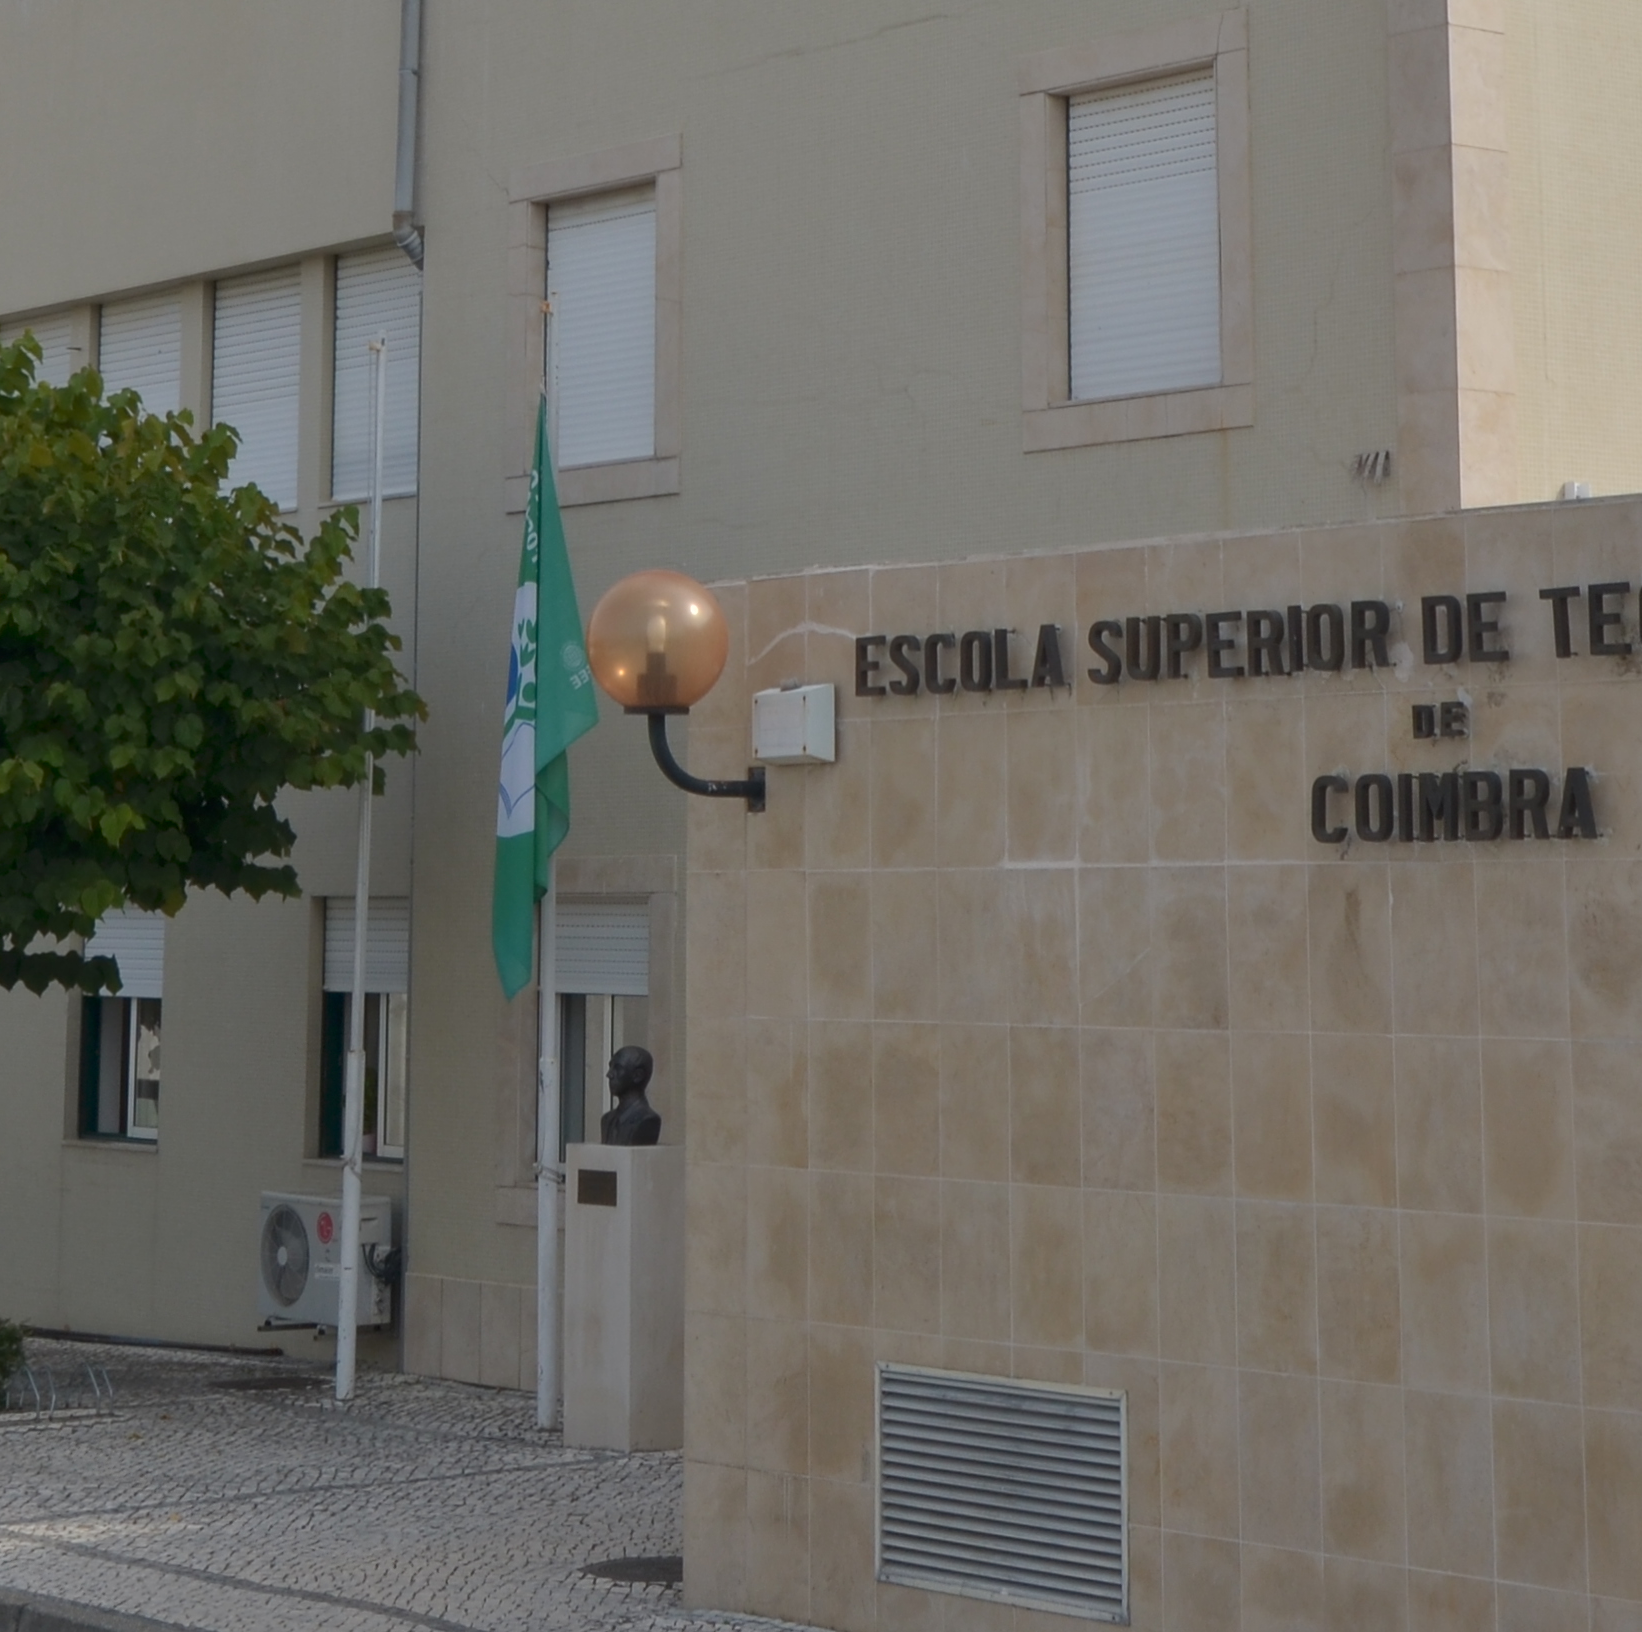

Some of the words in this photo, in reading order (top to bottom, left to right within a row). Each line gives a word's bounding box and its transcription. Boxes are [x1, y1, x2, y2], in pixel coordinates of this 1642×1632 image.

[854, 623, 1066, 698] ESCOLA
[1087, 599, 1393, 685] SUPERIOR
[1421, 590, 1511, 665] DE
[1411, 701, 1467, 740] DE
[1310, 766, 1599, 844] COIMBRA
